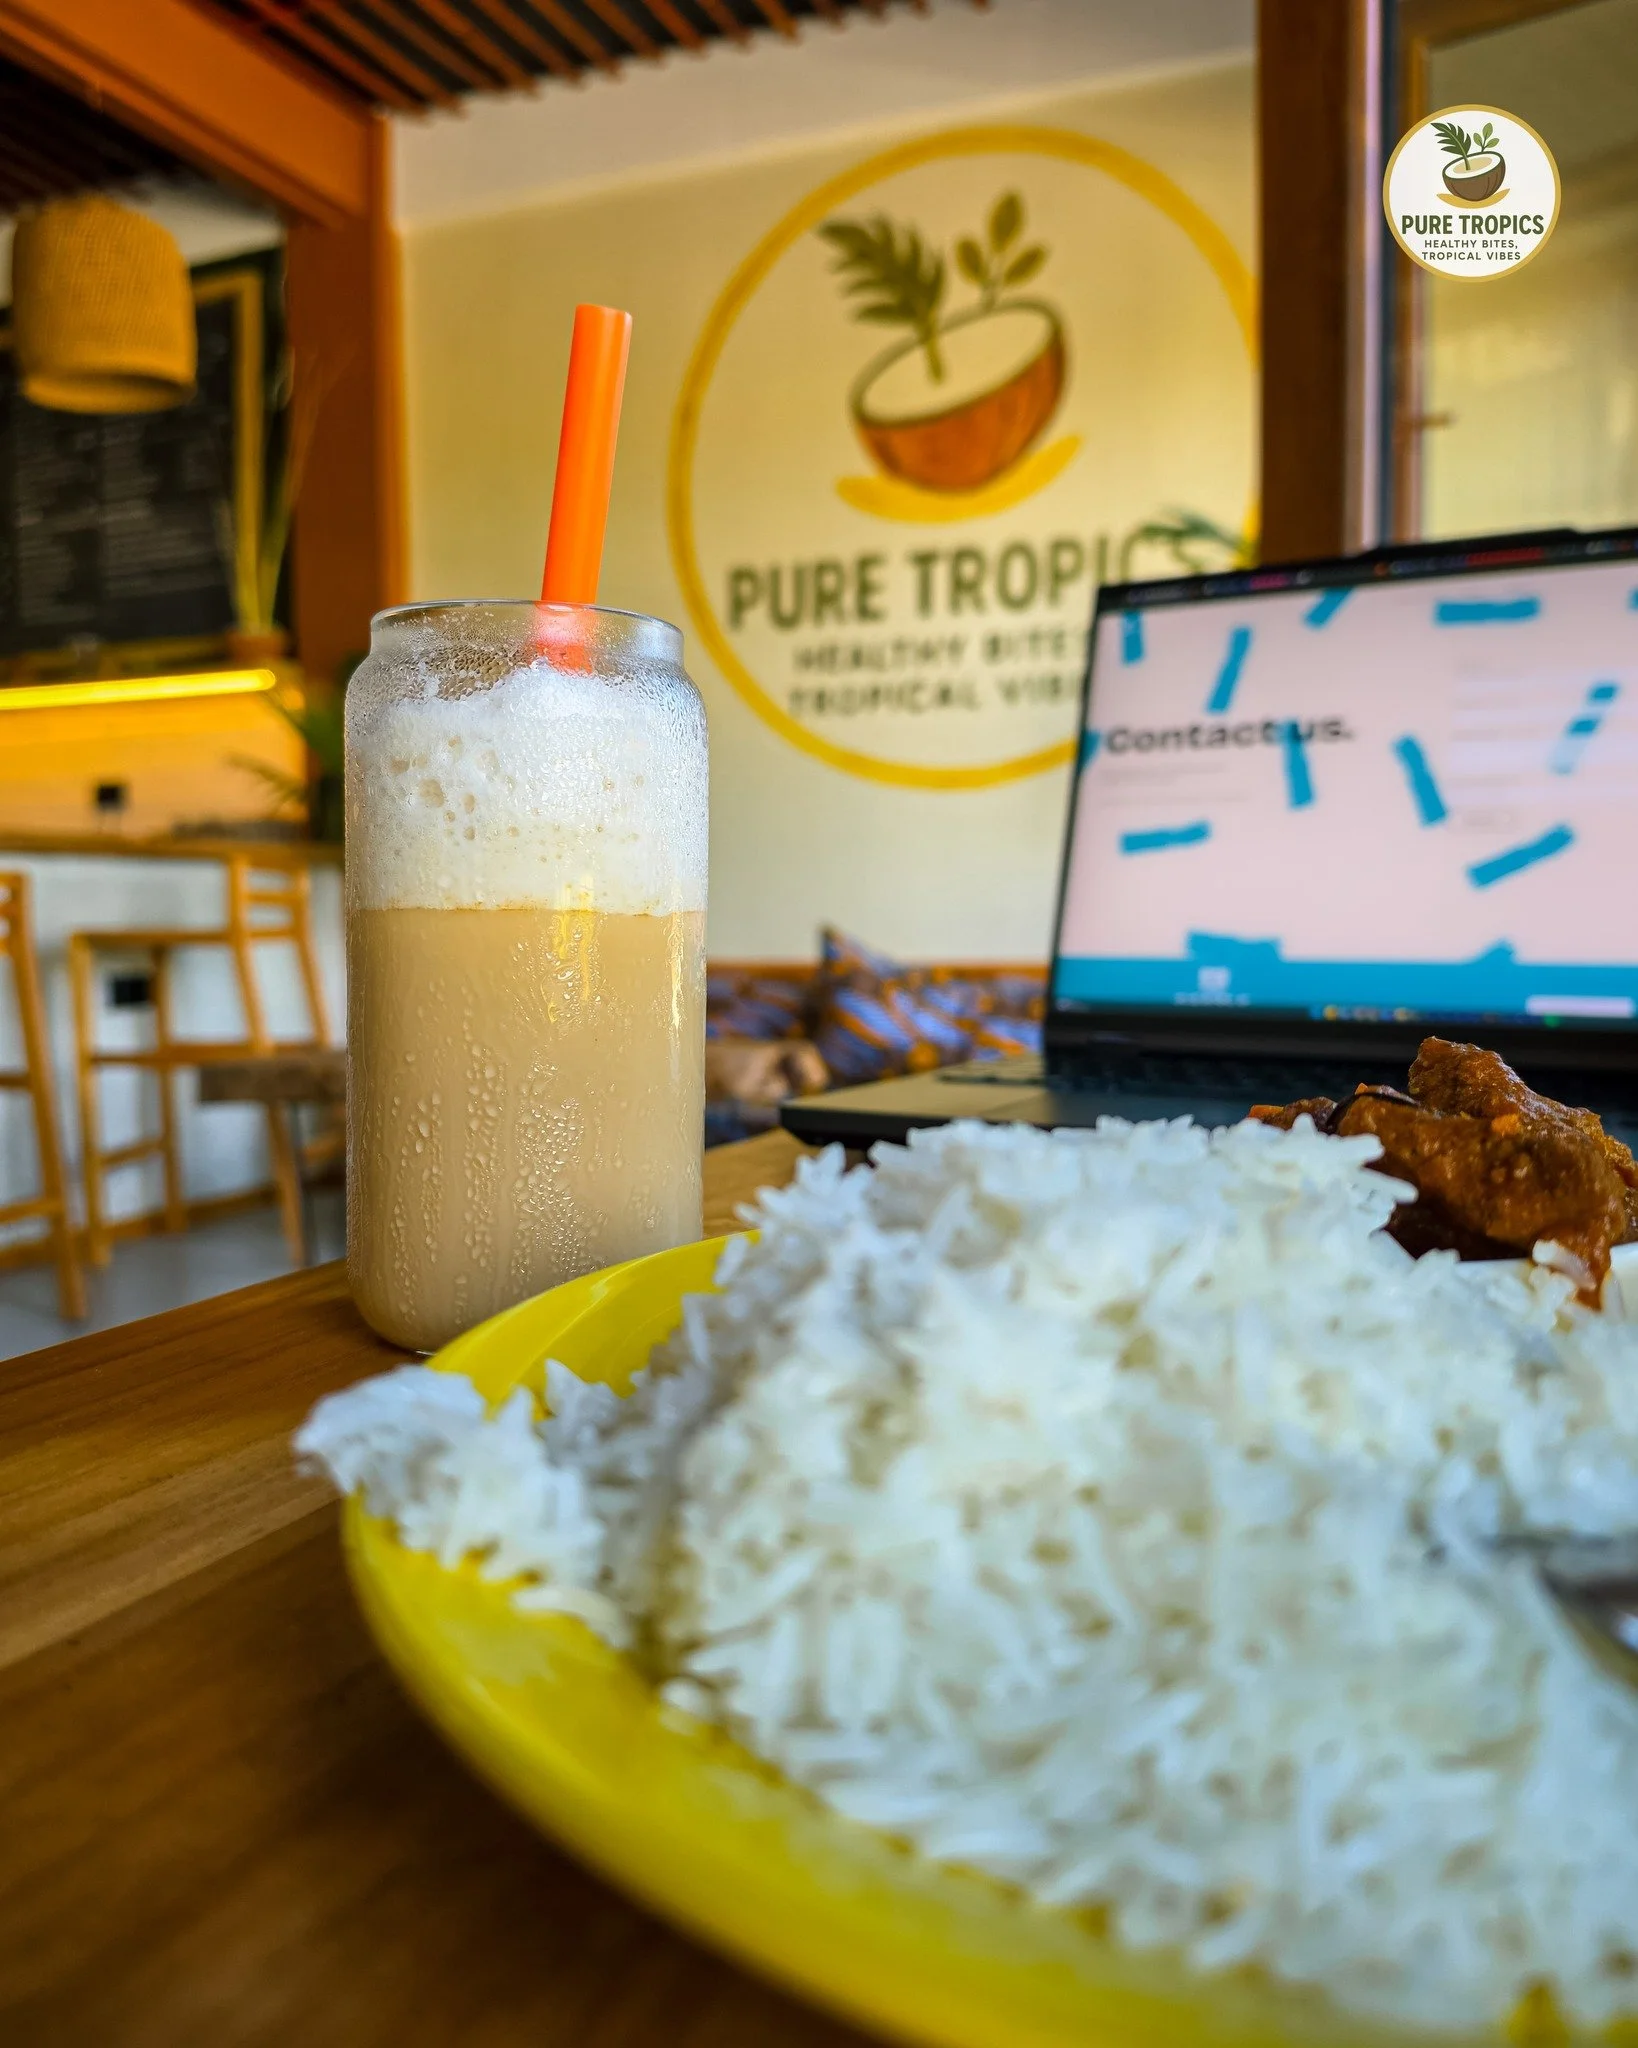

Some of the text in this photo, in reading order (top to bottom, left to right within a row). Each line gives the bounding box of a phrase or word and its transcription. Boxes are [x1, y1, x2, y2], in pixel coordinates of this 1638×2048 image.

[727, 550, 887, 632] PURE
[793, 634, 969, 674] HEALTHY
[789, 677, 983, 720] TROPICAL
[1105, 717, 1277, 755] Contact
